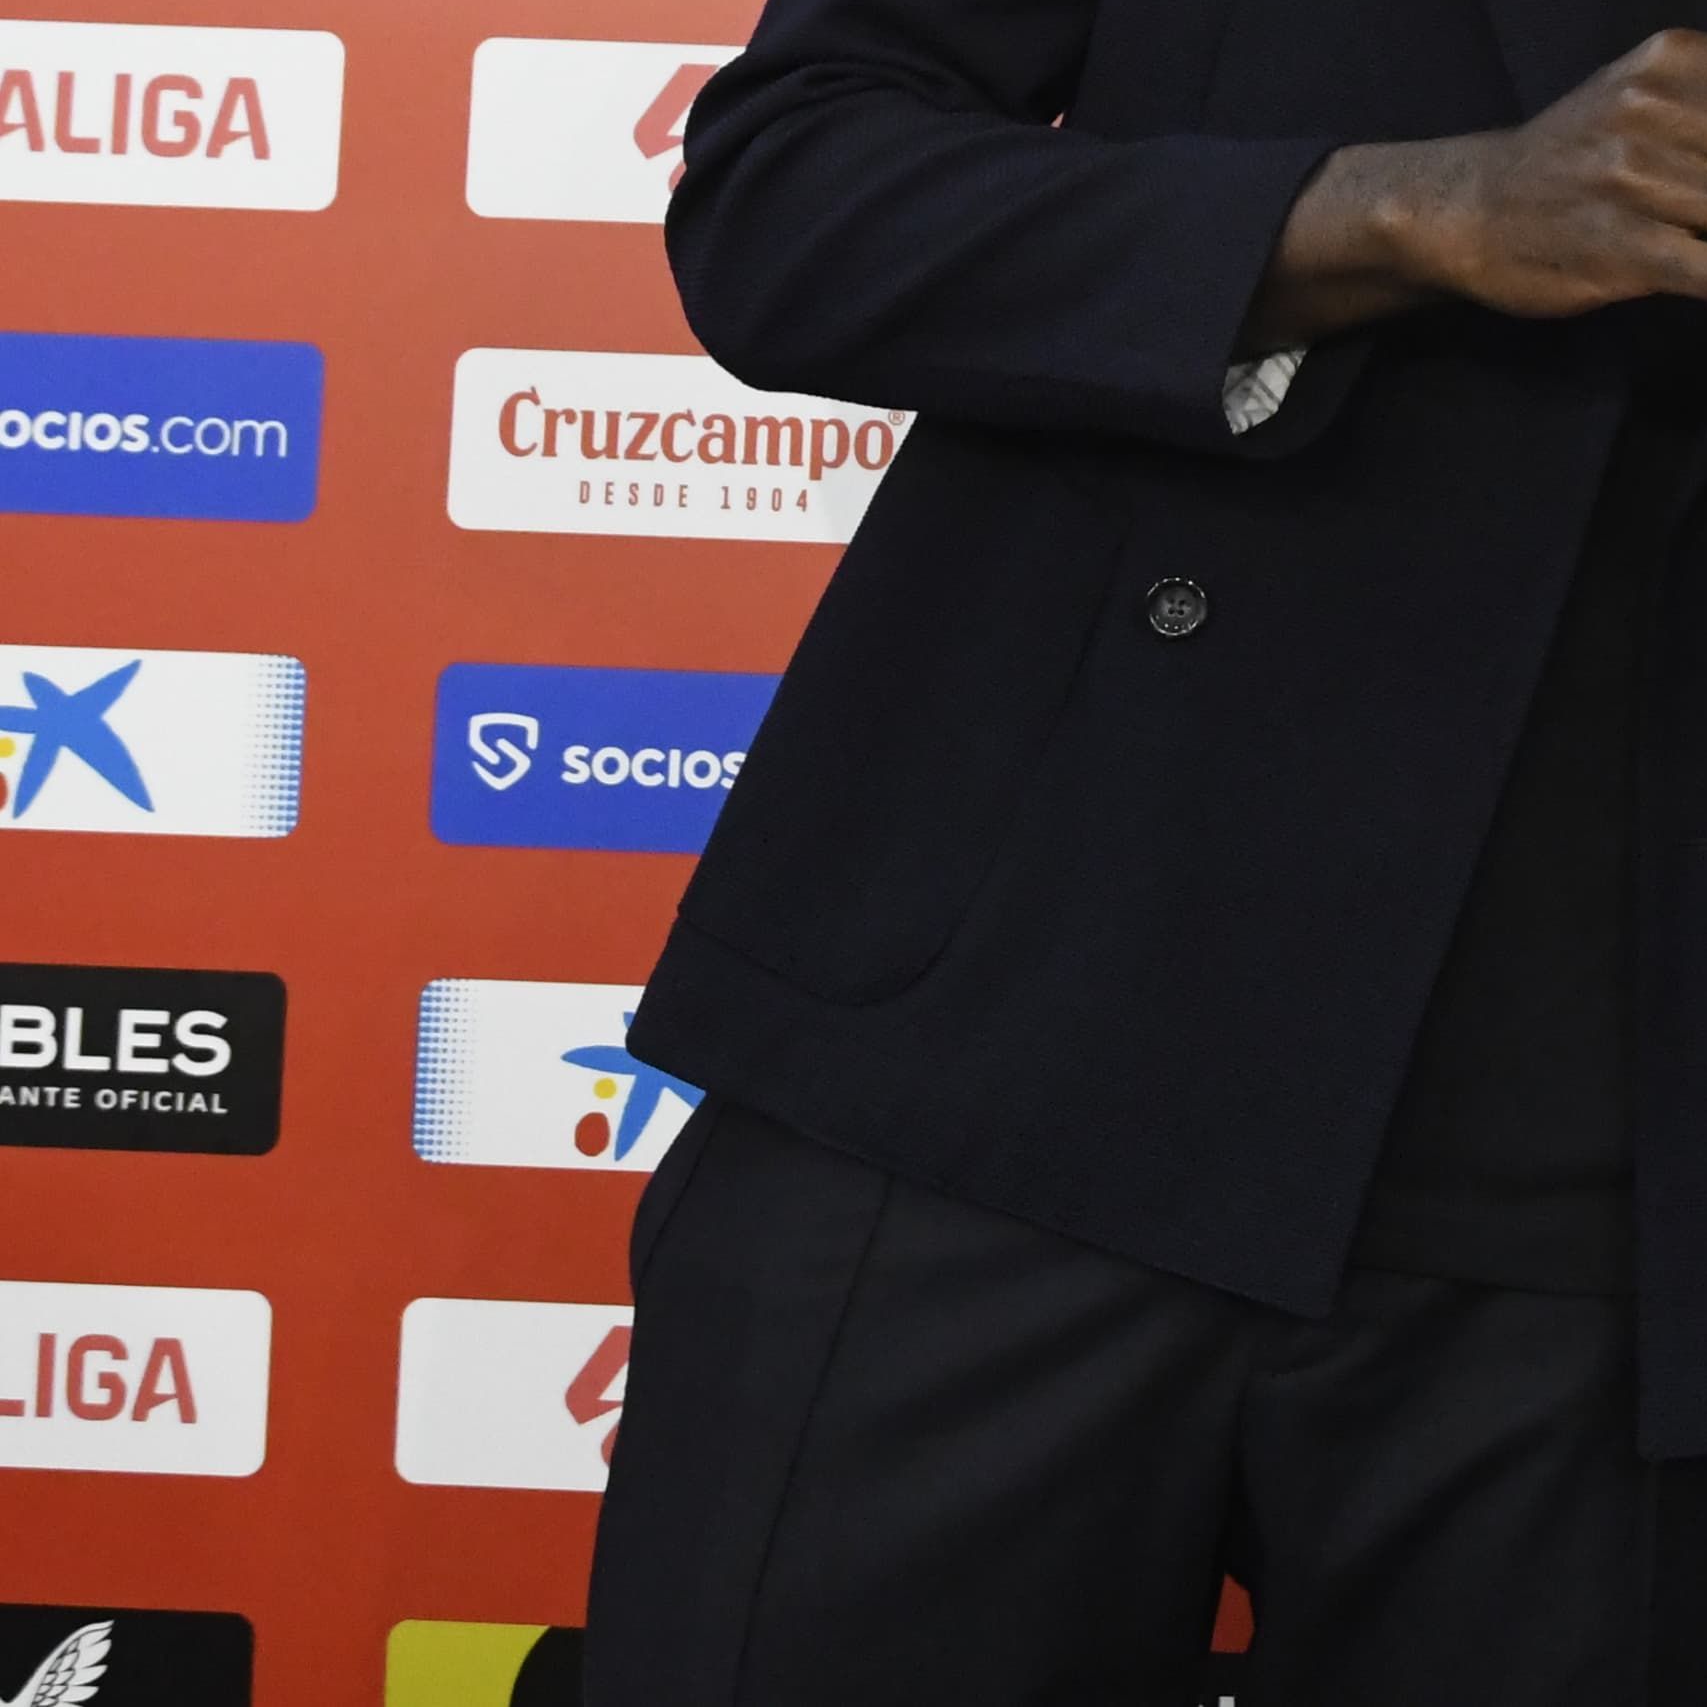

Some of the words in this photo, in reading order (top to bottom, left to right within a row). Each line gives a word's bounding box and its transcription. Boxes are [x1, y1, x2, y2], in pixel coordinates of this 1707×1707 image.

[0, 69, 270, 161] ALIGA
[0, 409, 288, 457] OCIOS.com
[578, 480, 689, 509] DESDE
[720, 485, 808, 513] 1904
[561, 745, 747, 790] SOCIOS
[0, 1004, 231, 1077] BLES
[94, 1088, 229, 1114] OFICIAL
